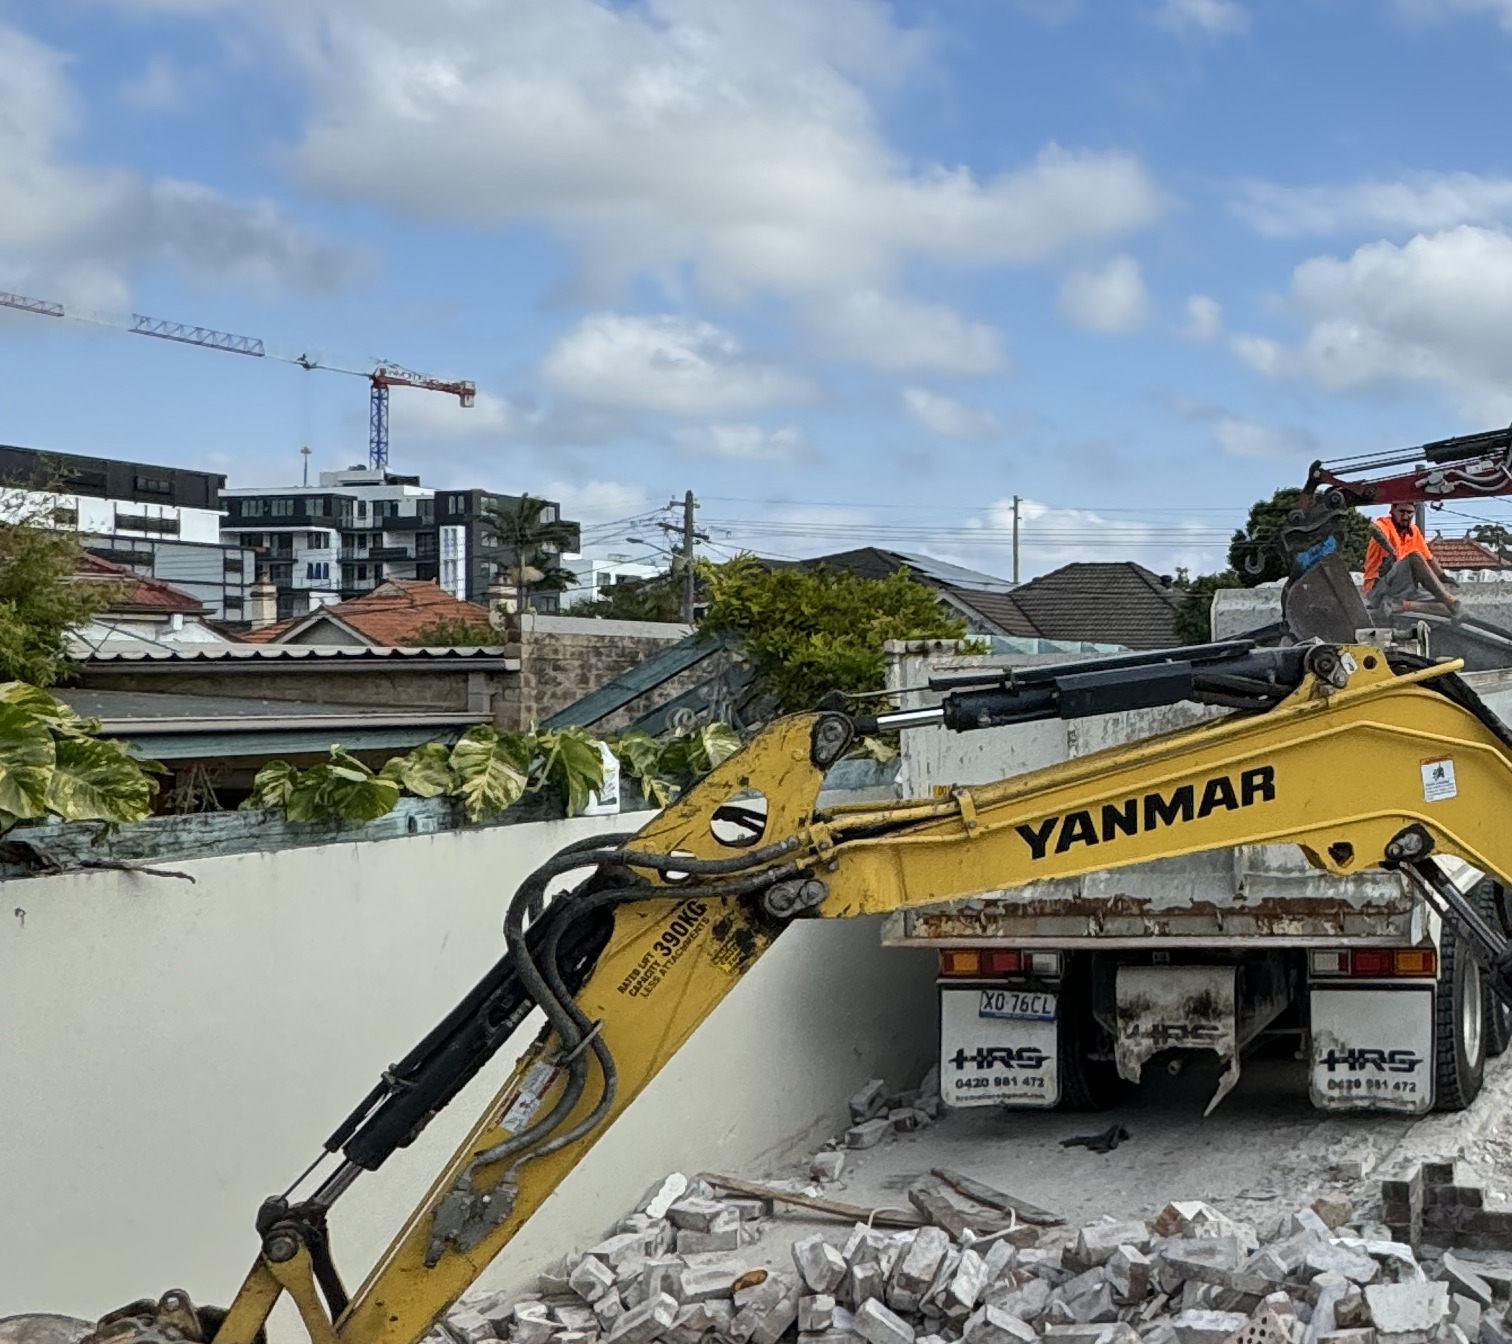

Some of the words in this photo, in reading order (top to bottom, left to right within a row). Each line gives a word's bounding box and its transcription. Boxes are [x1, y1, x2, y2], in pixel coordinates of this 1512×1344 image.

[1014, 765, 1276, 860] YANMAR
[653, 900, 708, 957] 390KG
[617, 967, 642, 994] RATED
[628, 959, 661, 997] CAPACITY
[641, 975, 661, 998] LESS
[1011, 994, 1051, 1014] 76CL
[949, 1047, 1051, 1070] HRS
[1319, 1048, 1423, 1073] HRS
[955, 1077, 990, 1089] 0420
[1022, 1076, 1045, 1088] 472
[1392, 1081, 1417, 1093] 472
